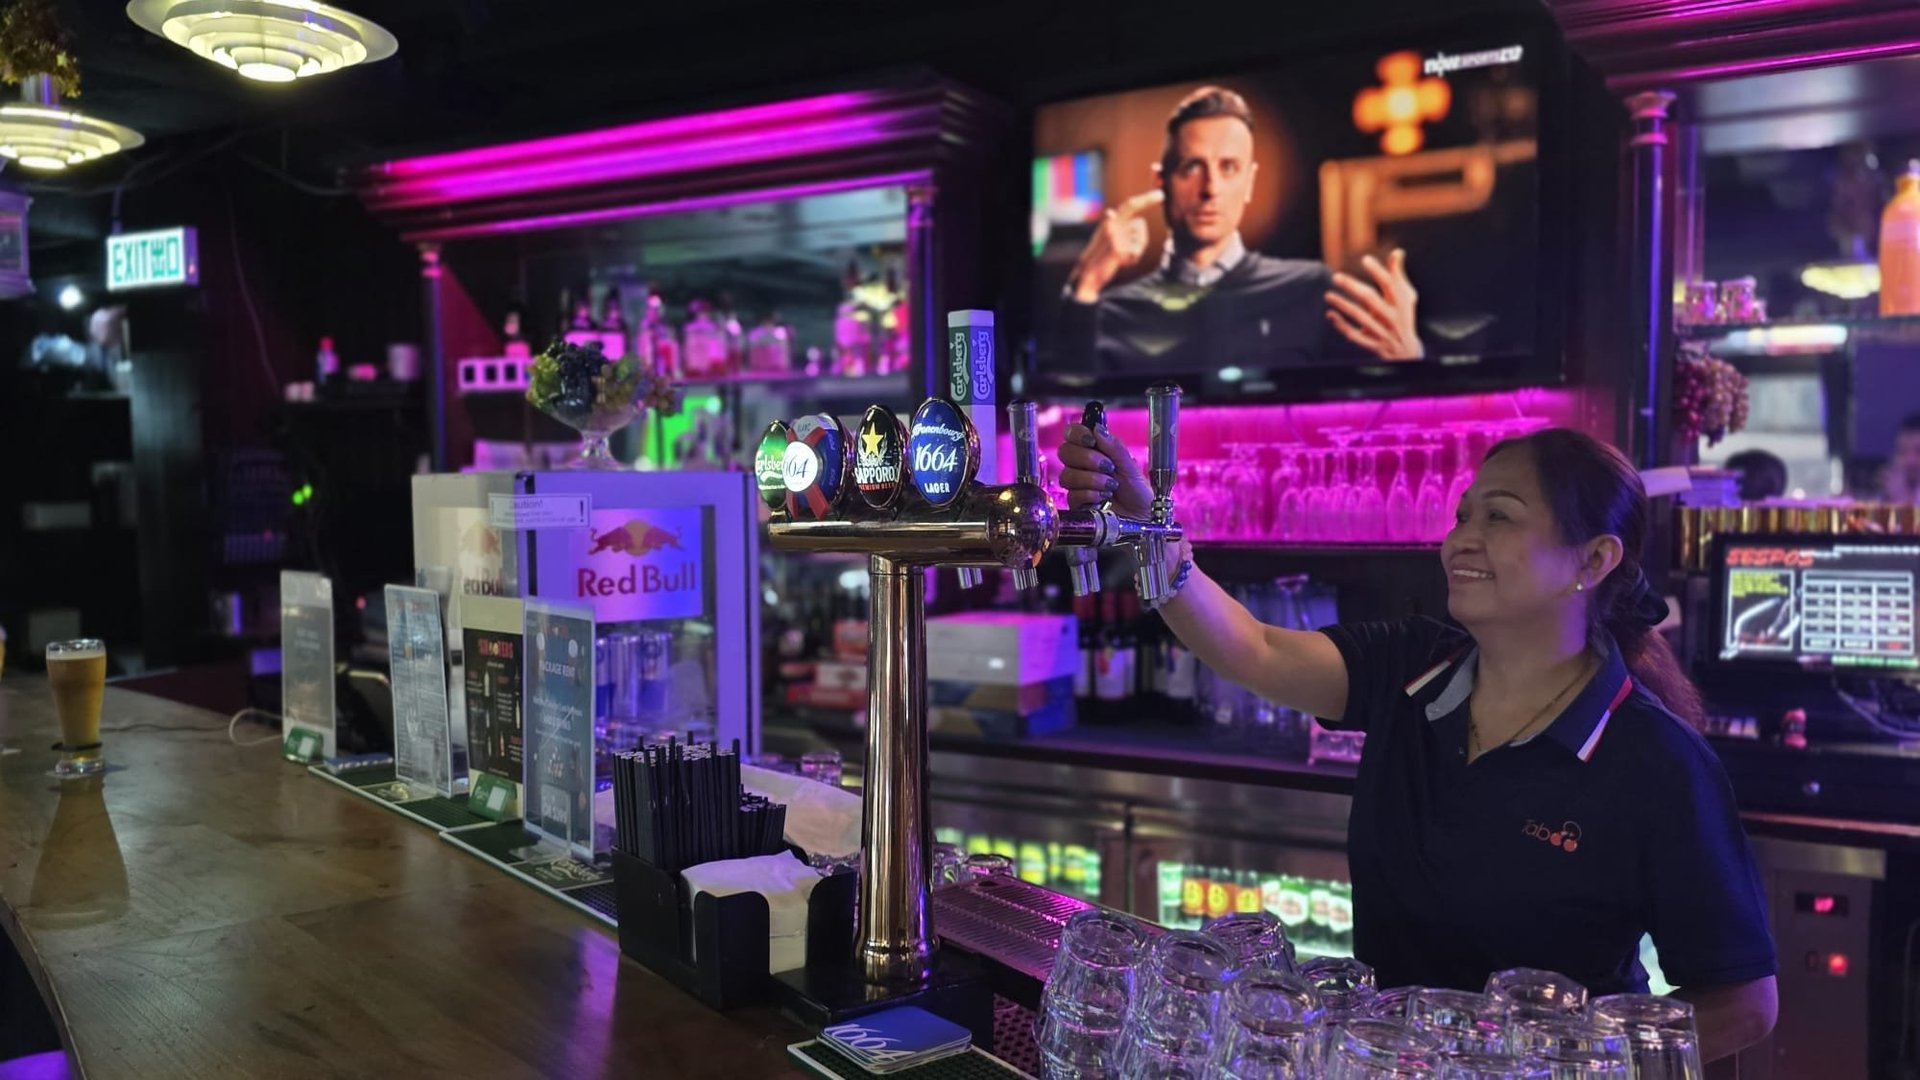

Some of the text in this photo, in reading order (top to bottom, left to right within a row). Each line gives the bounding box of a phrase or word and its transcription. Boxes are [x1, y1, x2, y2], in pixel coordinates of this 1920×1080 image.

[113, 242, 149, 283] EXIT
[150, 237, 180, 279] 出口
[950, 332, 969, 401] Carlsberg
[973, 330, 994, 400] Carlsberg
[911, 423, 966, 441] Kronenbourg
[854, 466, 896, 484] SAPPORO
[914, 443, 959, 472] 1664
[924, 482, 951, 493] LAGER
[577, 561, 696, 597] Red Bull
